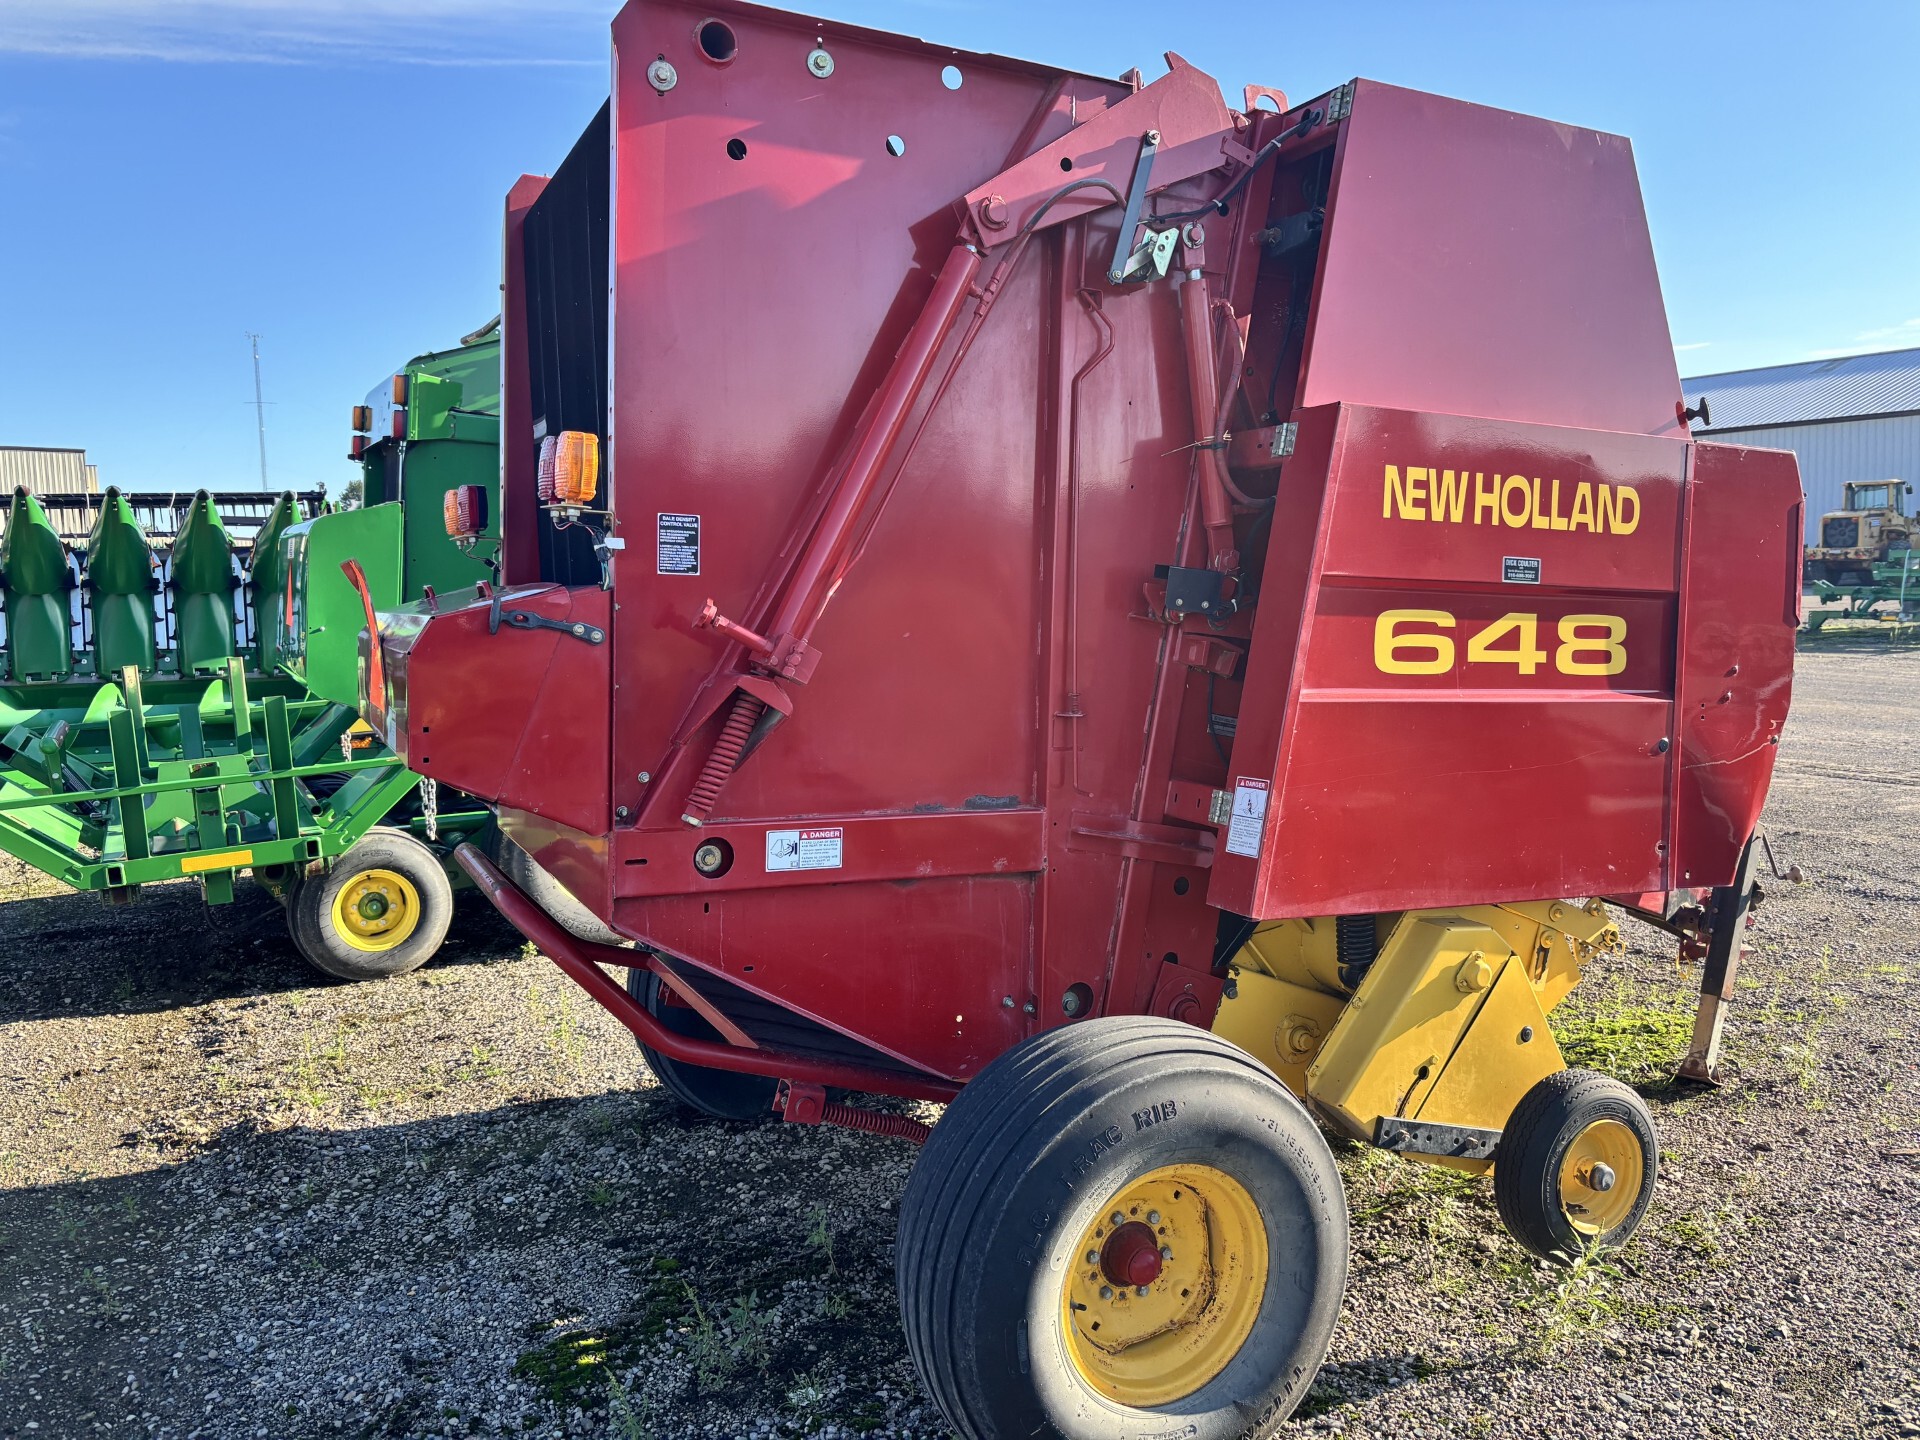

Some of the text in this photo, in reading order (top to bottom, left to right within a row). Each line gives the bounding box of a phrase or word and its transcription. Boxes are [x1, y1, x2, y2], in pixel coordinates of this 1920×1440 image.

[1382, 464, 1641, 536] NEW HOLLAND
[1373, 608, 1627, 676] 648
[1245, 781, 1266, 789] DANGER
[810, 830, 840, 839] DANGER
[1130, 1100, 1178, 1132] RIB
